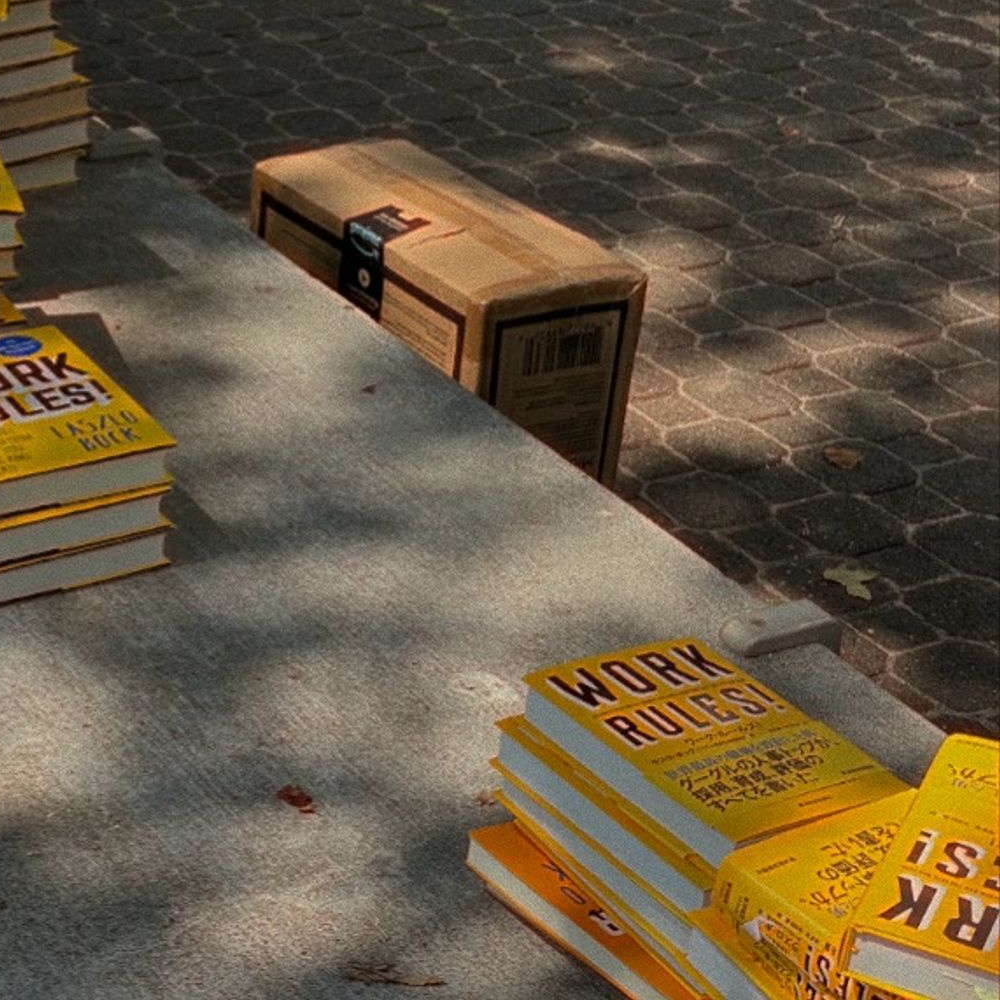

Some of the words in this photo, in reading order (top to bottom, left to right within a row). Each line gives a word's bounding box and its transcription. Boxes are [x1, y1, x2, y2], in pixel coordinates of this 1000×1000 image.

[50, 410, 138, 439] LASZLO
[78, 428, 141, 451] BOCK
[547, 643, 736, 709] WORK
[604, 683, 785, 748] RULES!
